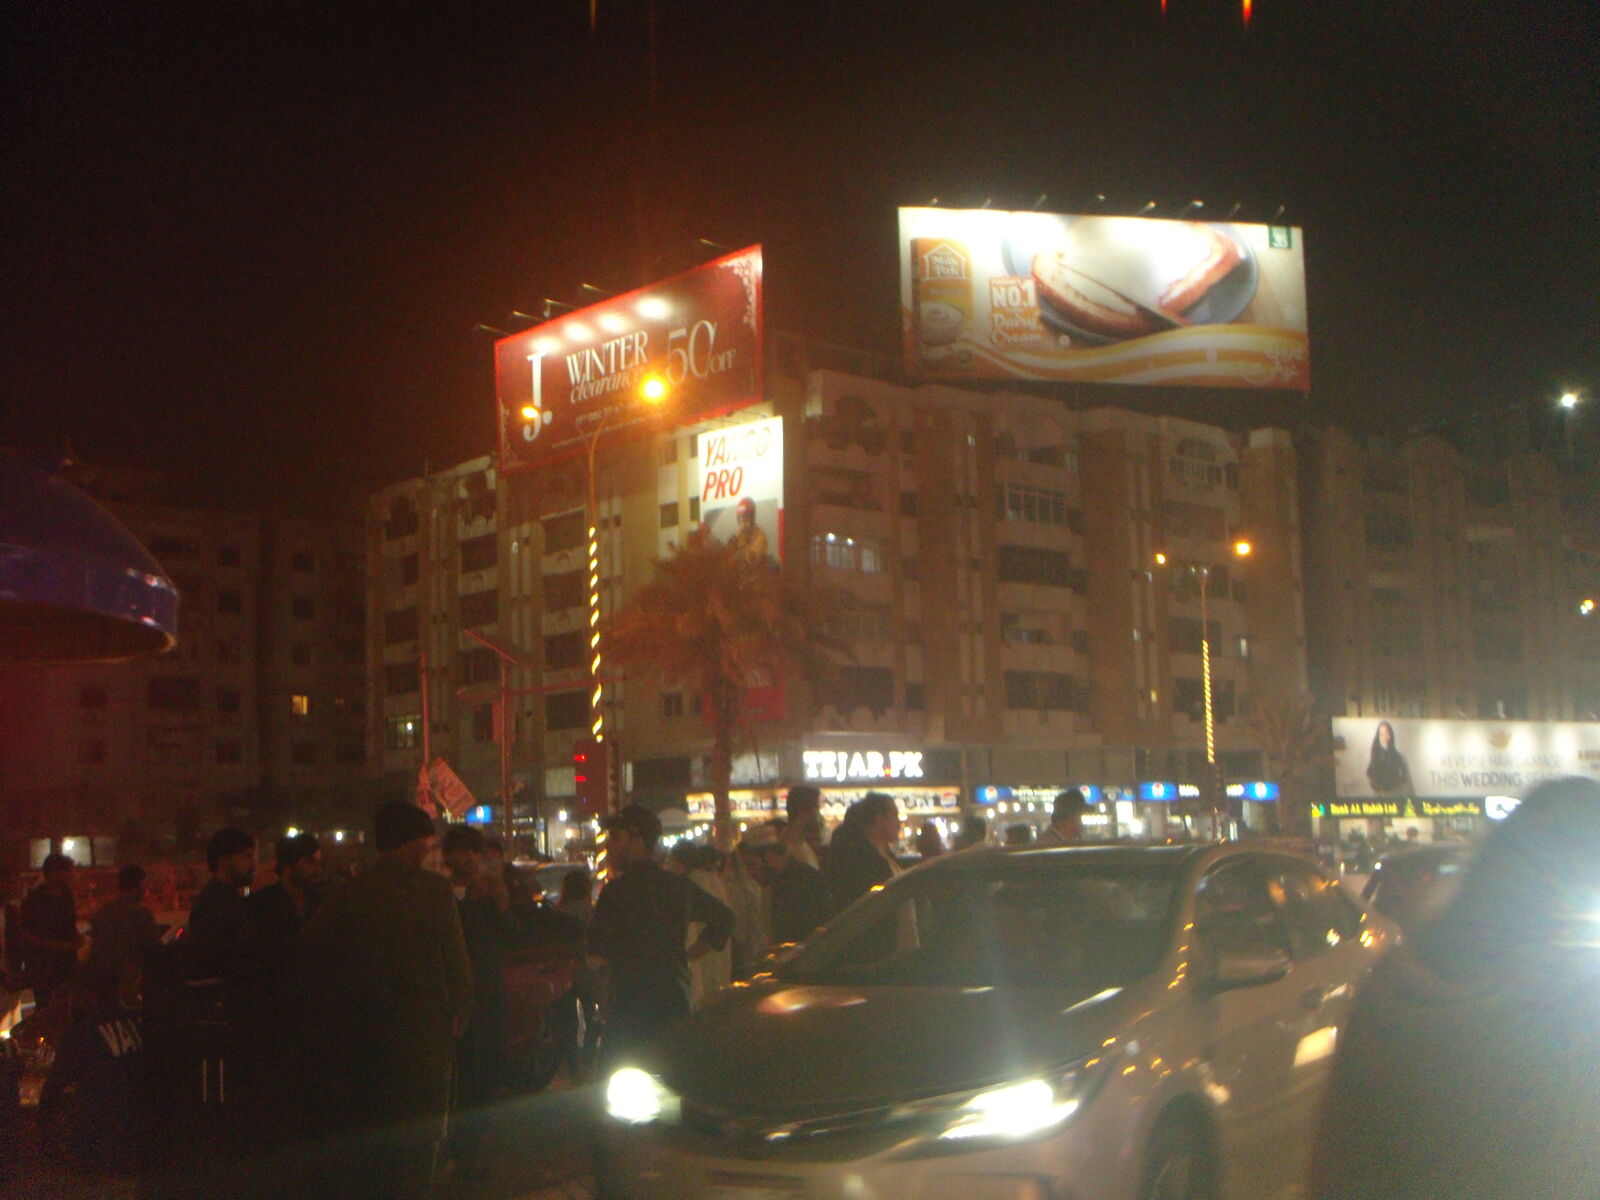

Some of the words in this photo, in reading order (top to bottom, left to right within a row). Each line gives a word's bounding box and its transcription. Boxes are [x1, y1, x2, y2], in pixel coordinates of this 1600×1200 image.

[566, 330, 649, 386] WINTER
[666, 319, 717, 386] 50
[703, 466, 743, 502] PRO
[803, 751, 924, 782] TEJAR.PK
[1461, 771, 1522, 788] WEDDING
